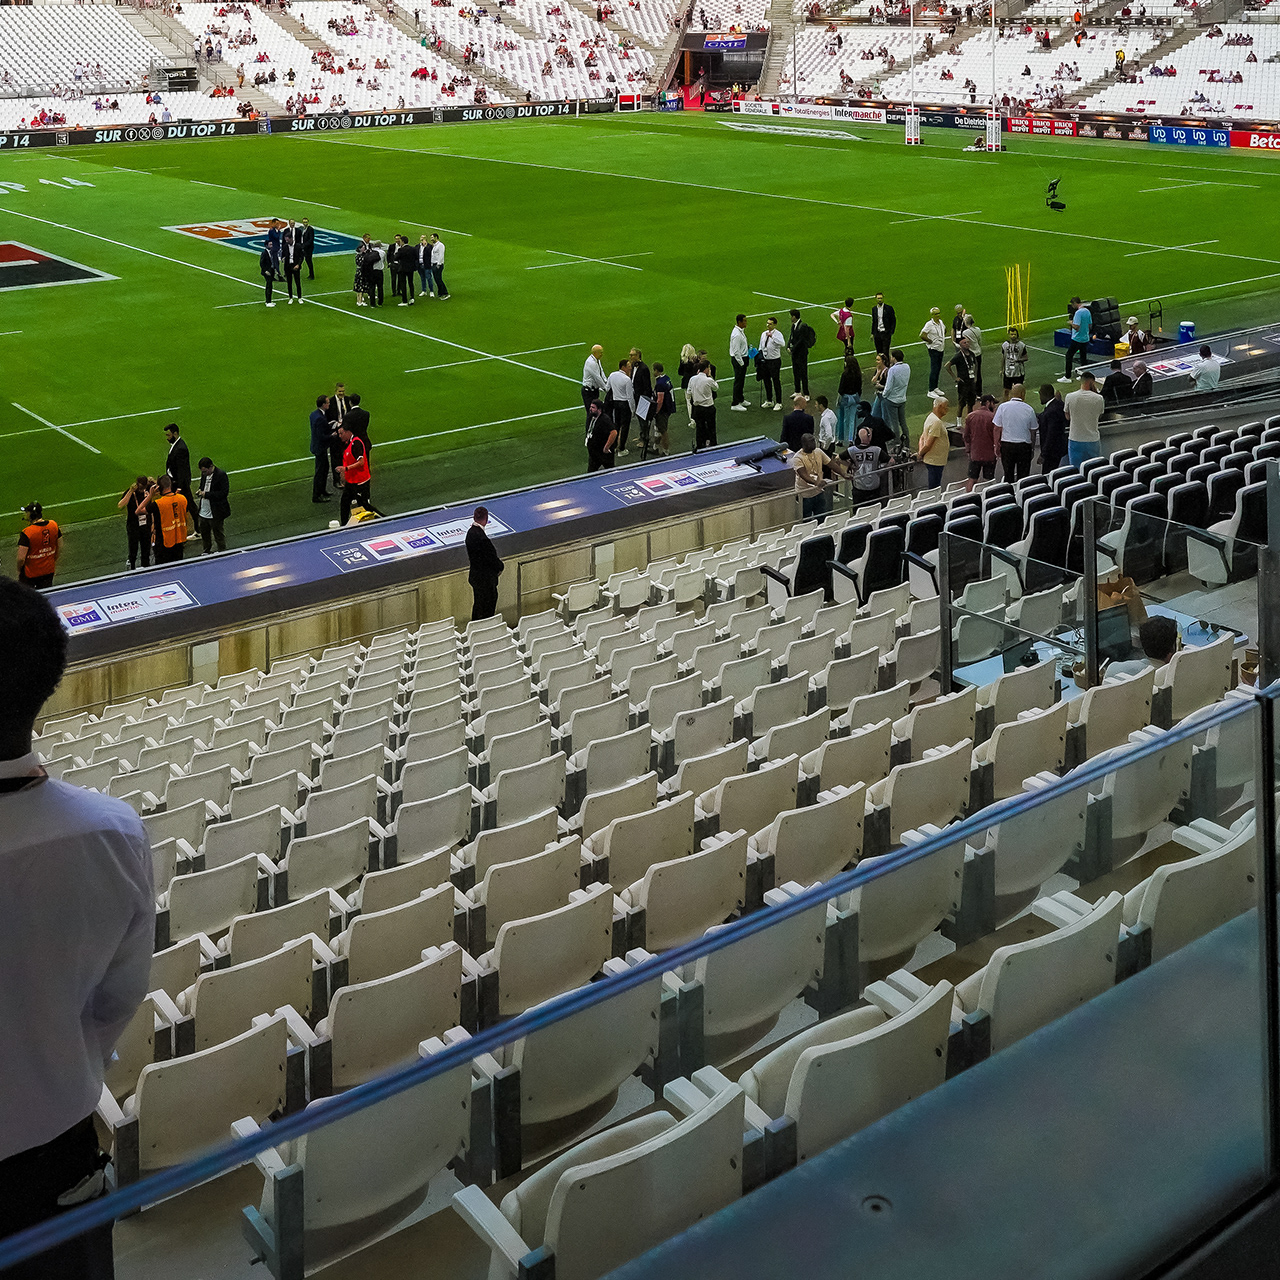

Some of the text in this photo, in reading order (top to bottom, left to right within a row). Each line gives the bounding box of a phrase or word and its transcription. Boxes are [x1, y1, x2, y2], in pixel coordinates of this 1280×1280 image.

[705, 40, 745, 49] GMF
[462, 104, 570, 120] SUR DU TOP 14
[794, 107, 830, 117] TotalEnergies
[887, 114, 927, 122] DEFEER
[291, 113, 414, 131] SUR DU TOP 14
[95, 122, 236, 144] SUR DU TOP 14
[12, 135, 30, 148] 14
[38, 176, 96, 189] 14
[613, 485, 636, 493] TOP
[436, 528, 463, 536] Inter
[410, 538, 432, 549] GMF
[333, 546, 360, 556] TOP
[342, 552, 369, 565] 14
[107, 600, 139, 612] Inter
[70, 610, 97, 626] GMF
